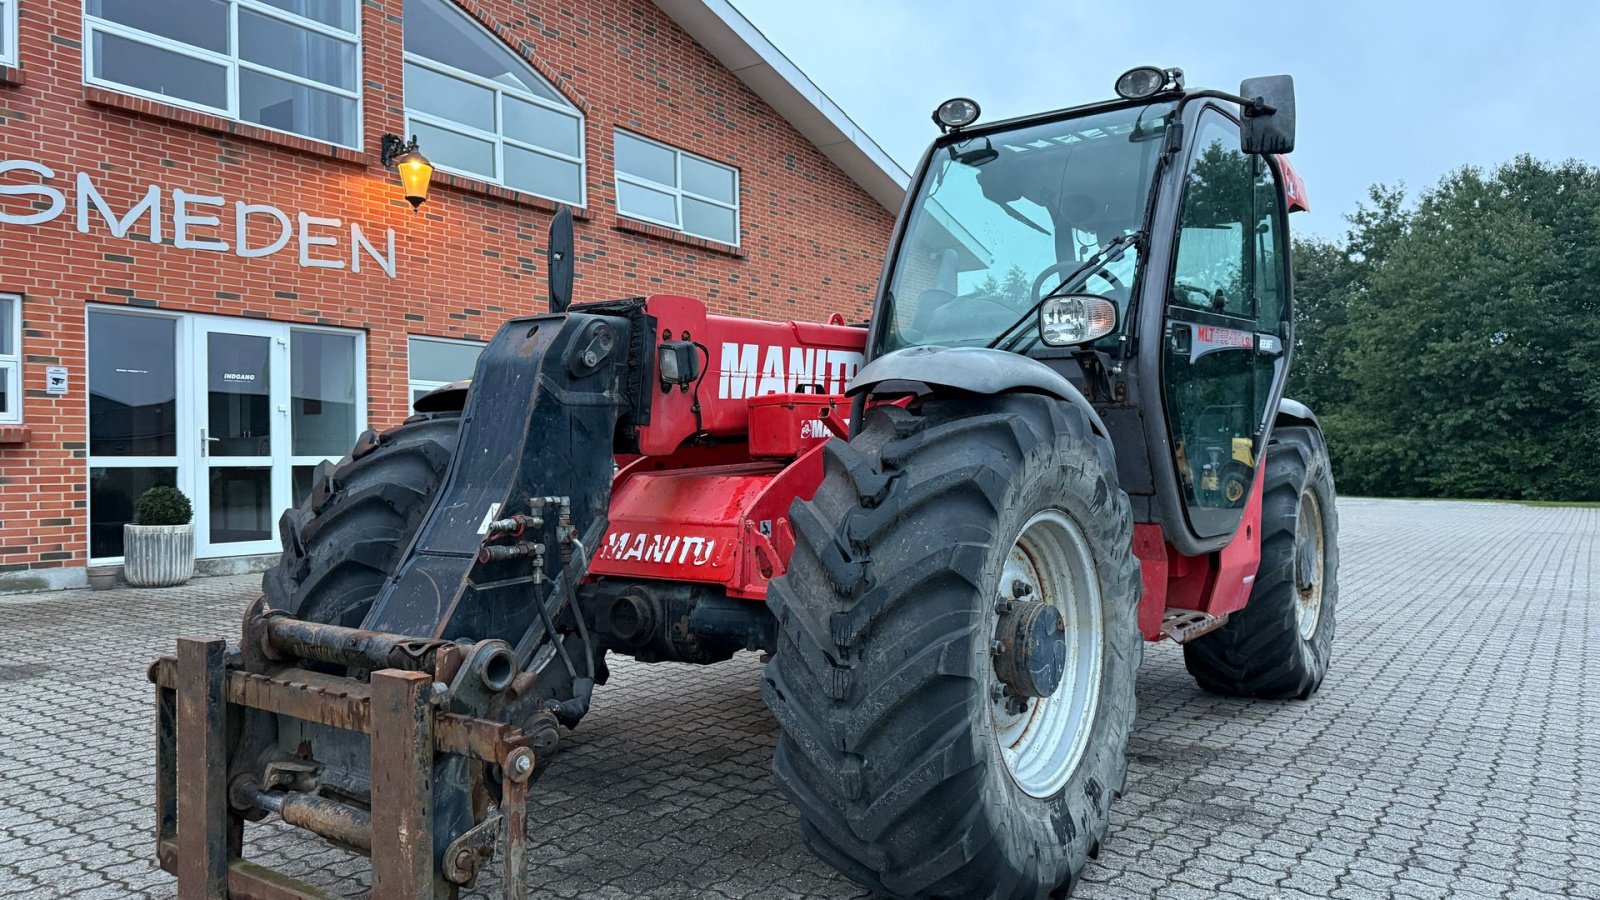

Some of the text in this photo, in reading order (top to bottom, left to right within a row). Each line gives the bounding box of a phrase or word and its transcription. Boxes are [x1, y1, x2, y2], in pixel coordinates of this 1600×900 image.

[0, 159, 396, 278] SMEDEN
[1198, 326, 1214, 343] MLT
[223, 373, 255, 381] INDGANG
[718, 342, 866, 400] MANITO
